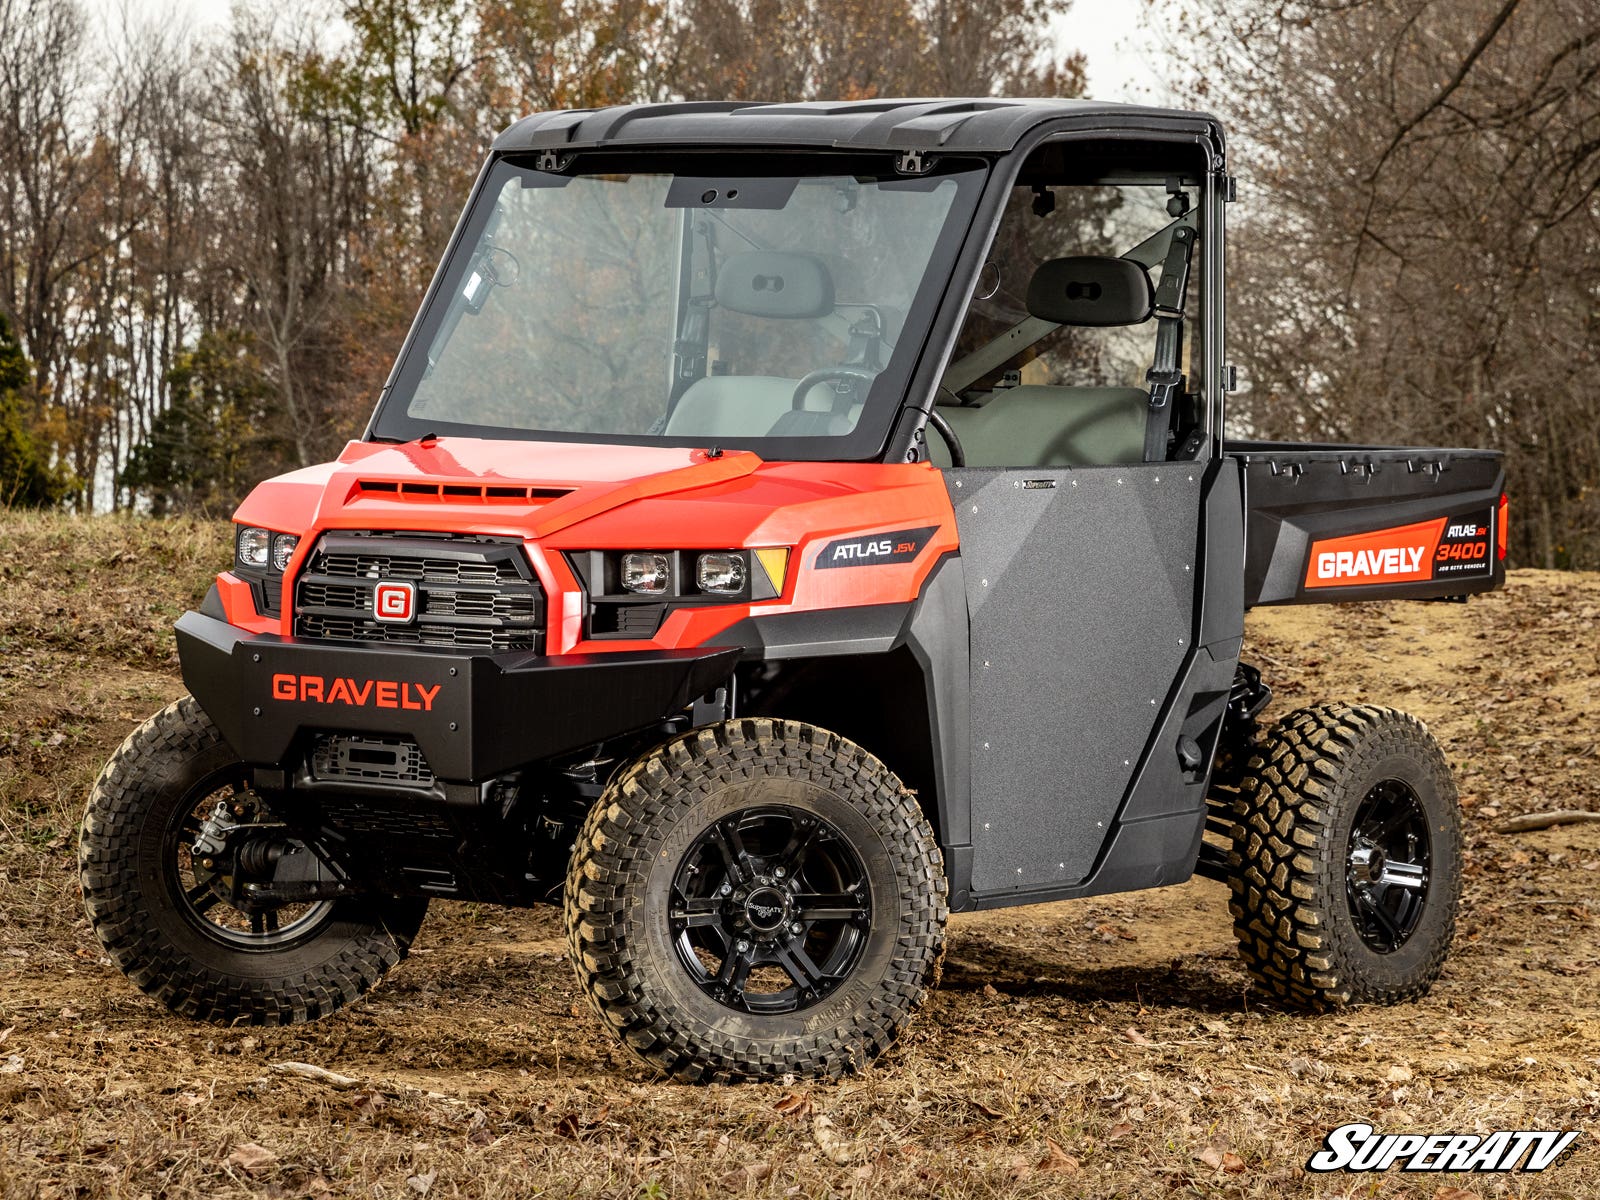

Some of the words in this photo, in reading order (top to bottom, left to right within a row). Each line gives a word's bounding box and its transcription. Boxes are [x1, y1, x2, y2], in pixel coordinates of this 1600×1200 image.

[1447, 524, 1476, 538] ATLAS
[833, 540, 892, 561] ATLAS
[893, 542, 916, 554] JSV
[1436, 541, 1487, 561] 3400
[1317, 546, 1425, 579] GRAVELY
[382, 590, 406, 614] G
[272, 673, 442, 711] GRAVELY
